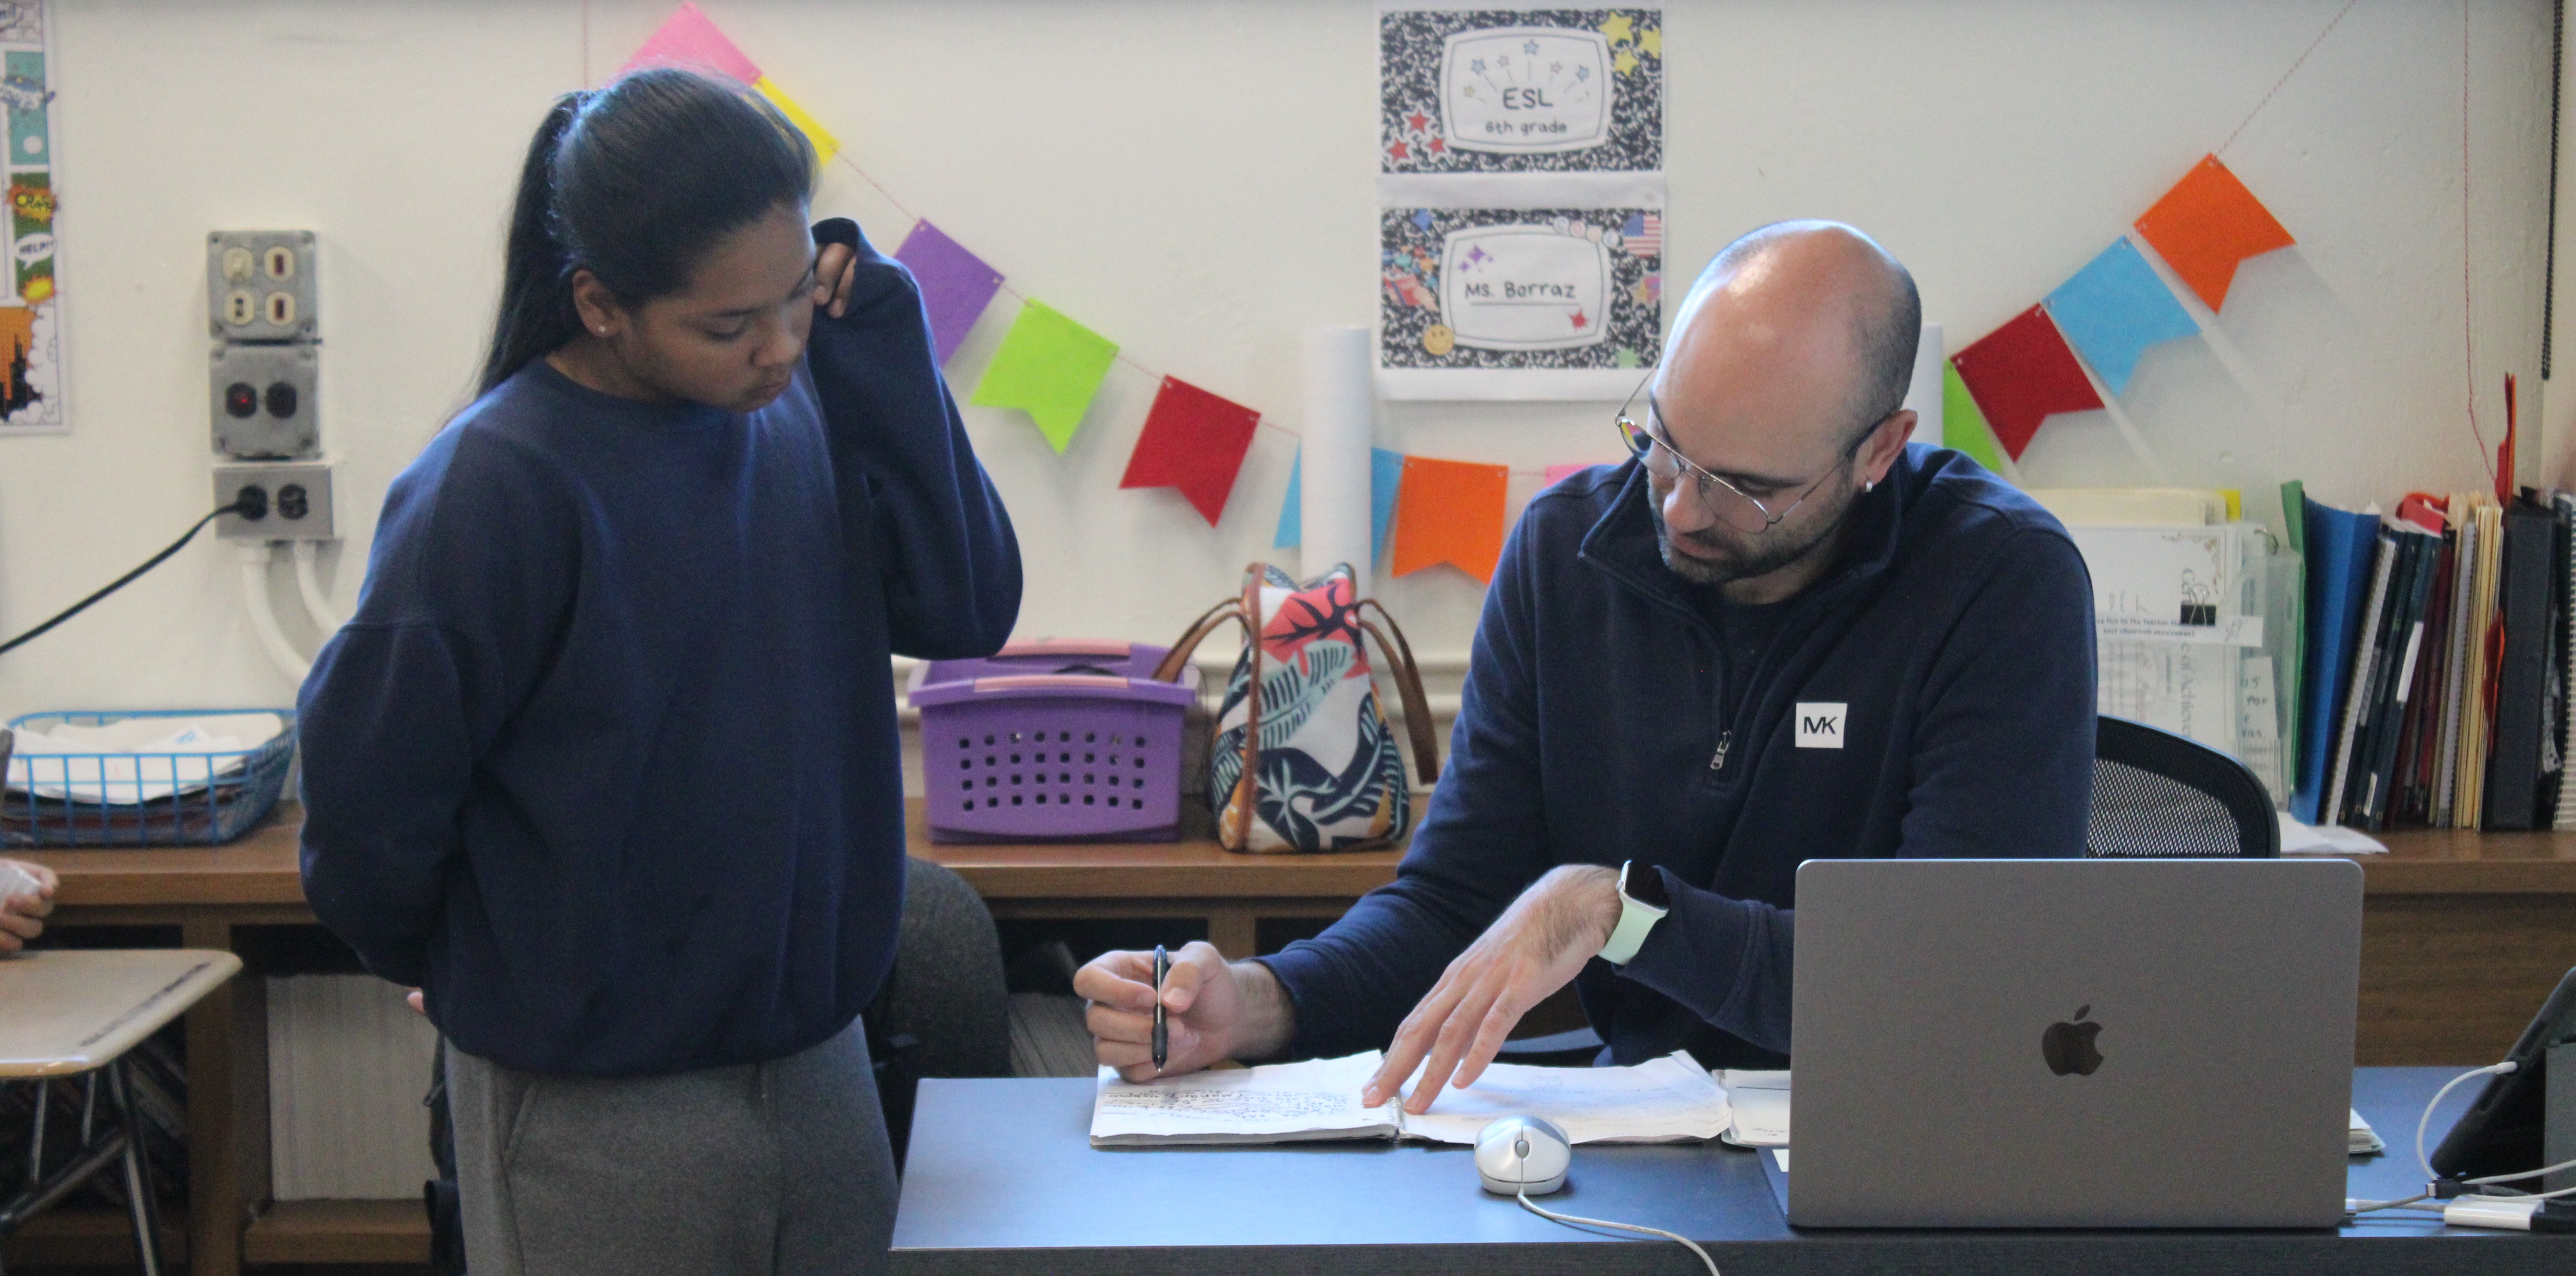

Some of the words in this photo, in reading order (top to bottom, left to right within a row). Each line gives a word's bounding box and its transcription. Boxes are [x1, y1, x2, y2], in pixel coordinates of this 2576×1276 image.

[1503, 87, 1554, 110] ESL
[1485, 120, 1513, 133] 6th
[1520, 121, 1567, 137] grade
[1465, 283, 1494, 298] Ms.
[1504, 281, 1576, 299] Borraz
[1804, 716, 1838, 734] MK
